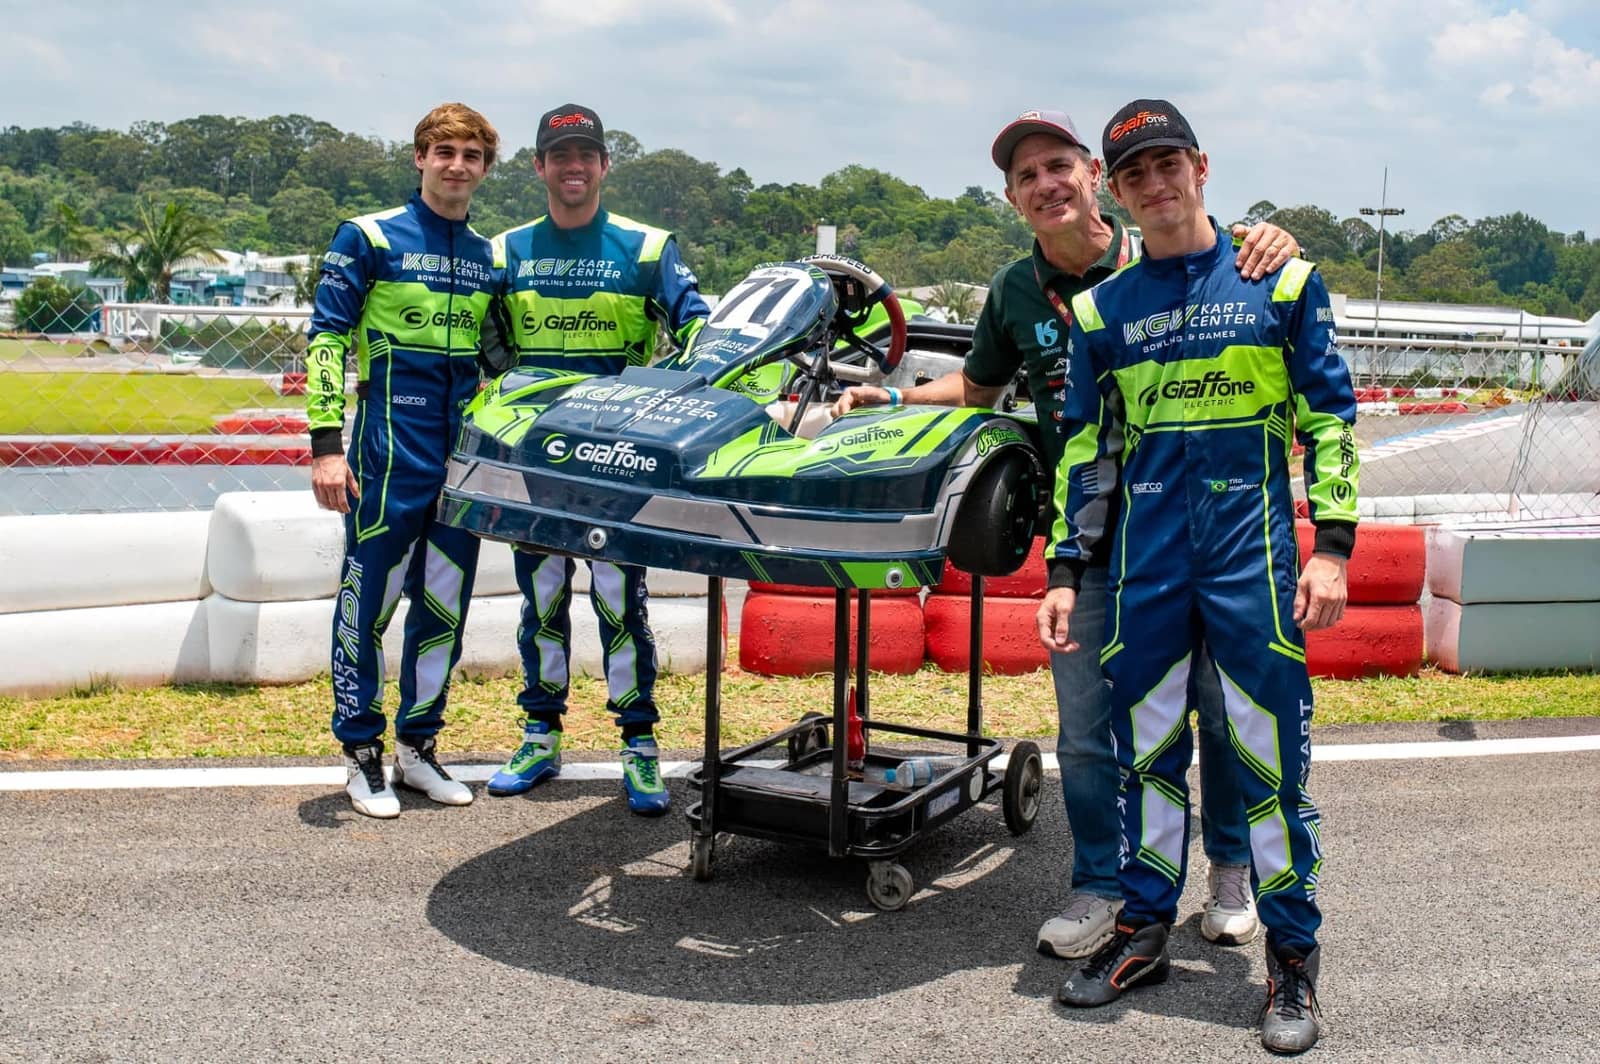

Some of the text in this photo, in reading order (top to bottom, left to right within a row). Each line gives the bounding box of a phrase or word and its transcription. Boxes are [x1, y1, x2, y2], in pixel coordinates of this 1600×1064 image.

[402, 252, 483, 273] KGV KART
[517, 258, 615, 278] KGV KART
[417, 275, 451, 283] BOWLING
[461, 280, 481, 289] GAMES
[455, 268, 490, 282] CENTER
[568, 268, 621, 279] CENTER
[711, 277, 800, 324] 71
[544, 311, 617, 331] Giaffone
[1123, 302, 1247, 345] KGV KART
[1190, 314, 1256, 328] CENTER
[1142, 335, 1183, 353] BOWLNG
[1199, 330, 1236, 340] GAMES
[1162, 371, 1255, 399] Giaffone
[634, 395, 718, 421] CENTER
[655, 388, 716, 409] KART
[1184, 398, 1235, 409] ELECTRIC
[565, 402, 622, 414] BOWLING
[635, 408, 682, 424] GAMES
[840, 426, 904, 446] Giaffone
[575, 441, 657, 472] Giaffone
[592, 464, 635, 478] ELECTRIC
[337, 556, 363, 664] KGV
